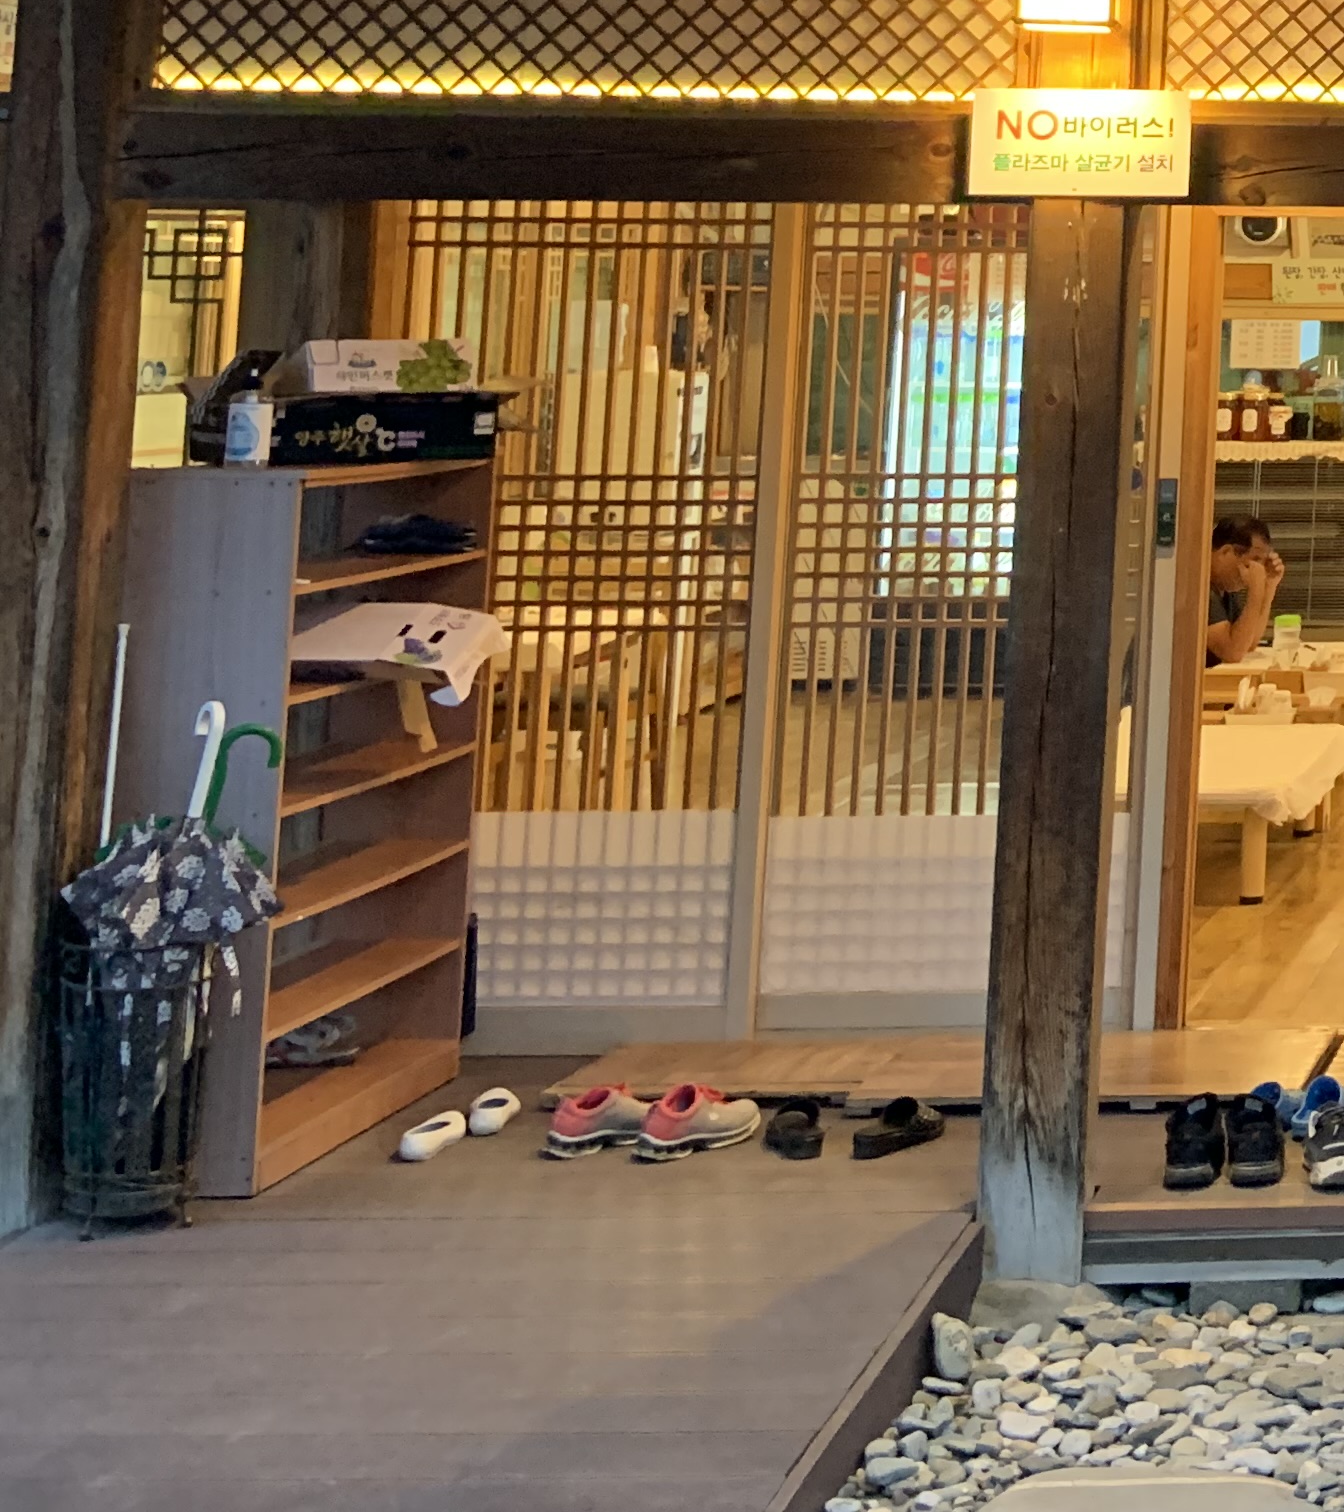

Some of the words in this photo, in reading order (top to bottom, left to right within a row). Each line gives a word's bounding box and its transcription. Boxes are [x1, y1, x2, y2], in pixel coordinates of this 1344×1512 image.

[993, 153, 1067, 172] 플라즈마
[1075, 154, 1130, 172] 살균기
[1137, 154, 1173, 172] 설치
